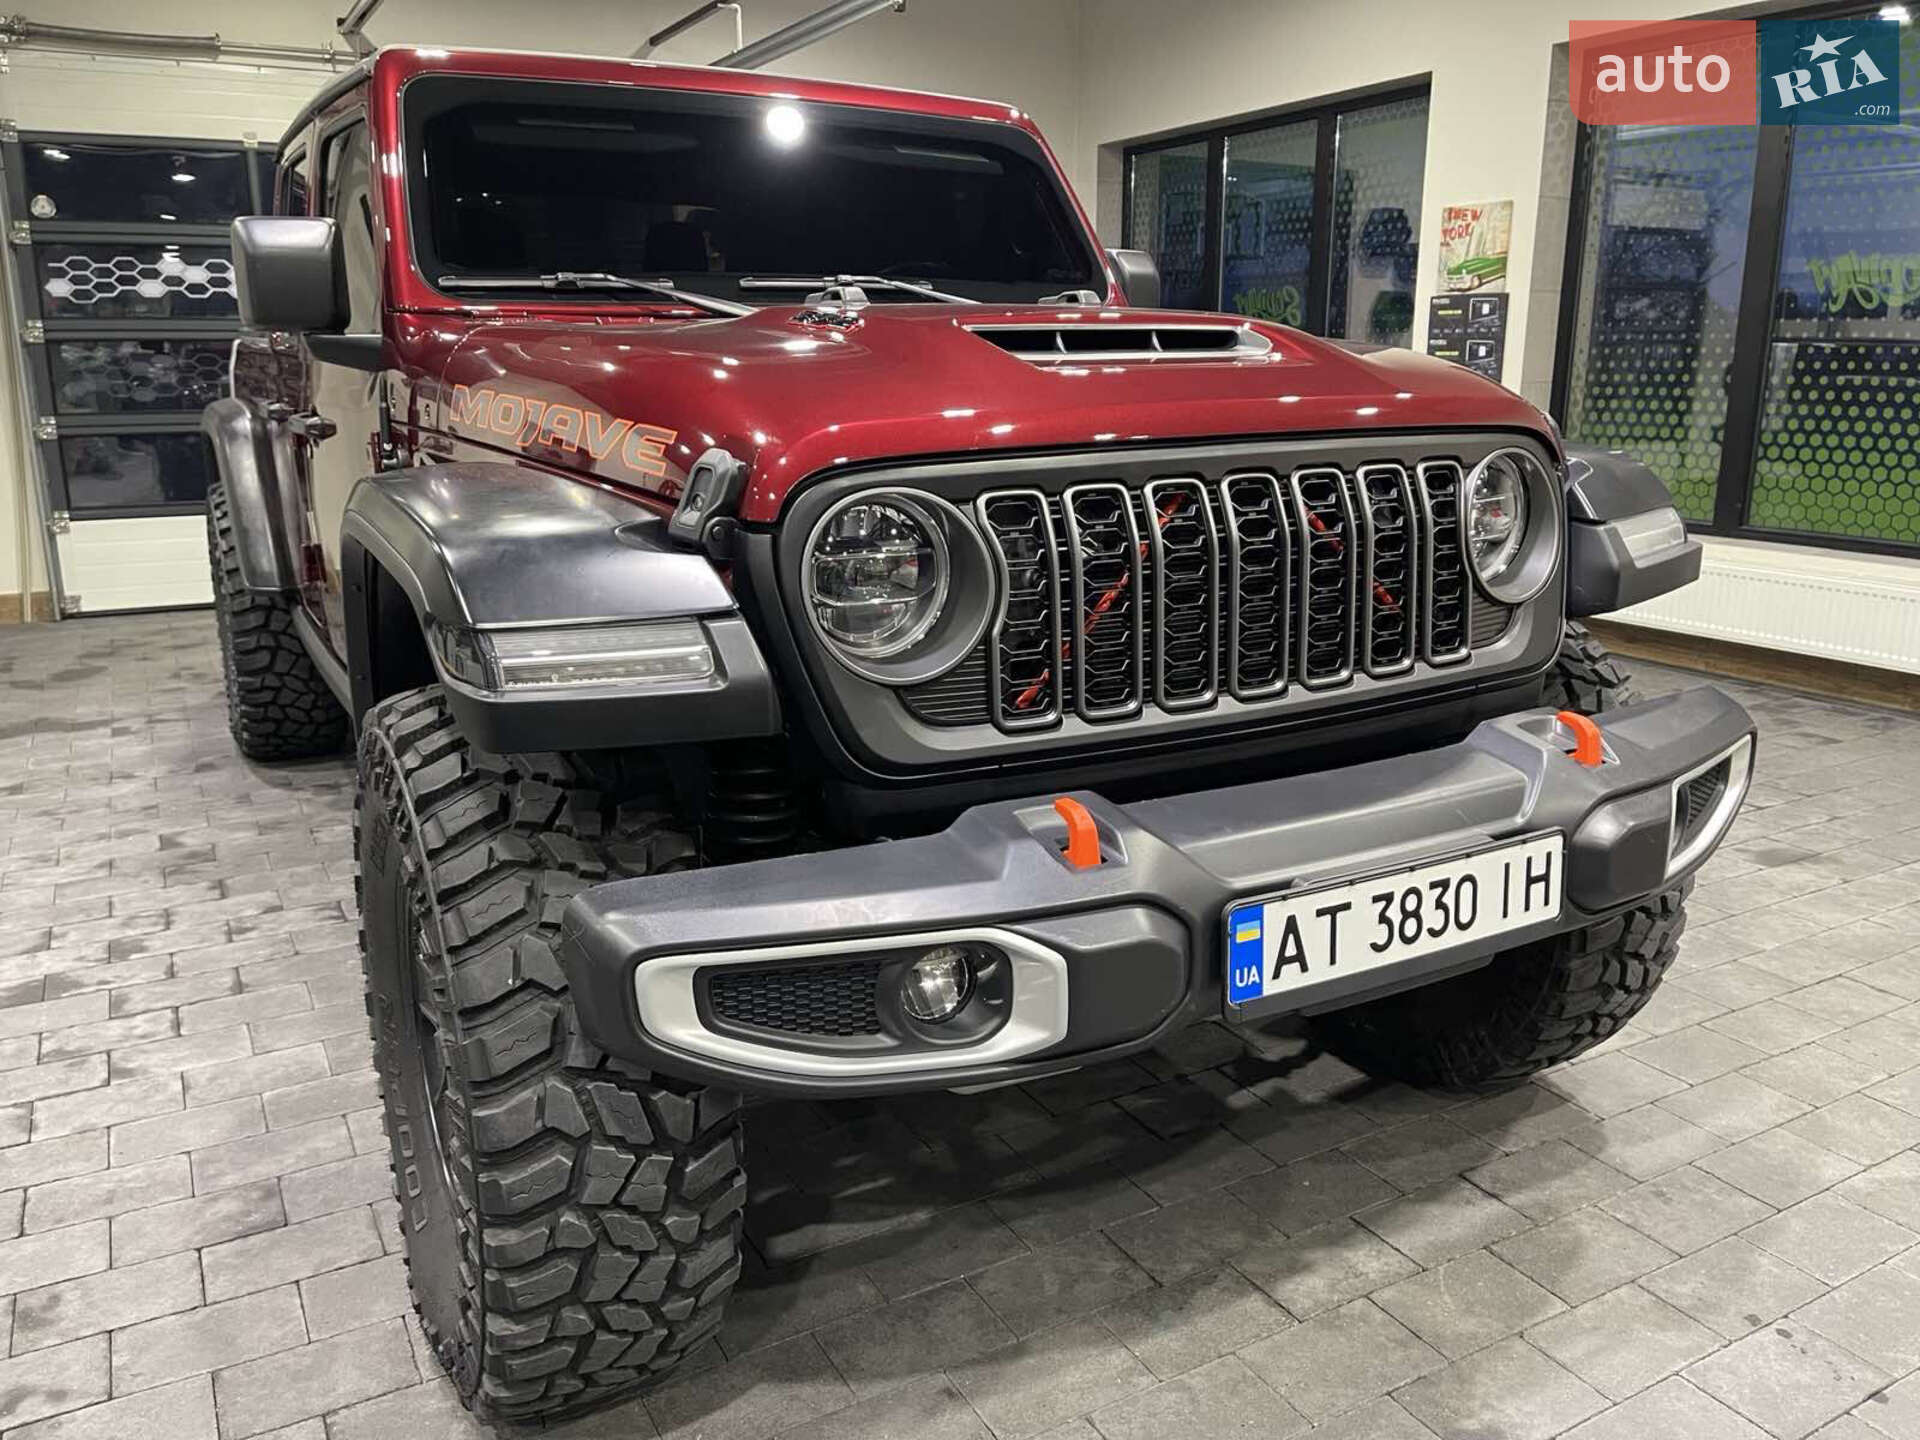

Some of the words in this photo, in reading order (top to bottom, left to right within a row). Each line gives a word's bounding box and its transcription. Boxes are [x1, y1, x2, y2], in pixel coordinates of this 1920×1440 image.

[450, 384, 678, 476] MOJAVE
[1271, 901, 1352, 980] AT
[1369, 873, 1478, 953] 3830
[1502, 850, 1552, 919] IH
[1236, 967, 1260, 988] UA
